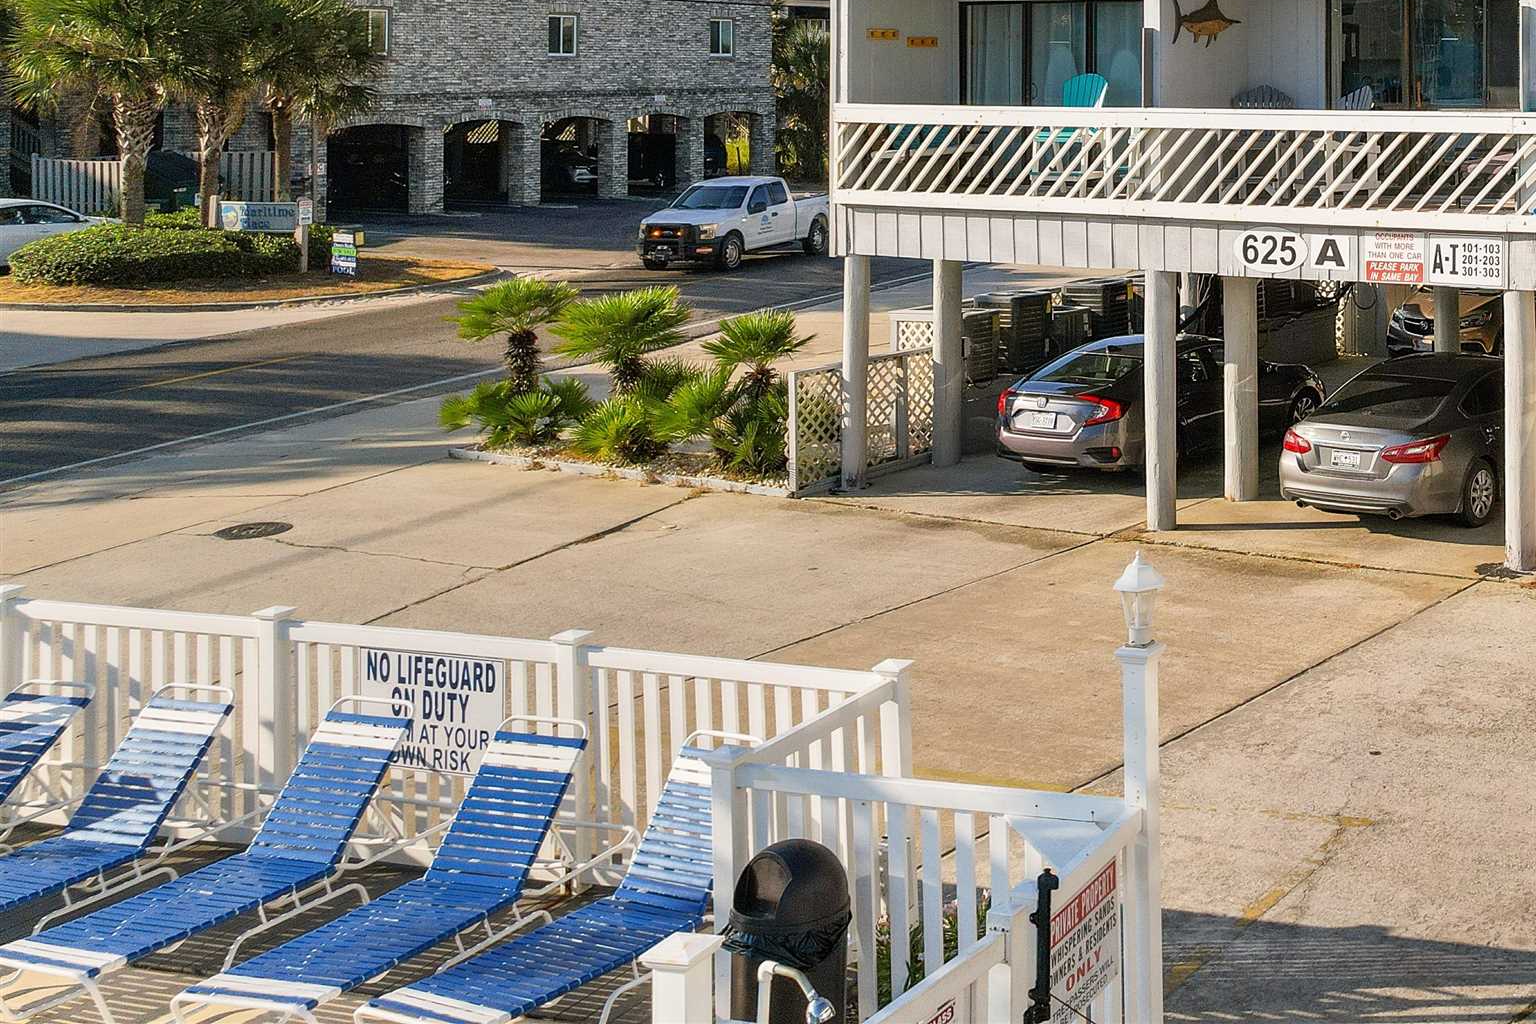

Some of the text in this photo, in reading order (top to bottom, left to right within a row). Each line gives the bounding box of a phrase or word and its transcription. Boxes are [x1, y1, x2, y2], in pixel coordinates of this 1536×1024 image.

[1242, 234, 1297, 266] 625
[1375, 232, 1414, 241] OCCUPANTS
[1394, 243, 1415, 251] MORE
[1315, 239, 1345, 267] A
[1369, 262, 1418, 272] PLEASE PARK
[1407, 252, 1422, 260] CAR
[1370, 271, 1418, 282] IN SAME BAY
[367, 651, 496, 693] NO LIFEGUARD
[391, 687, 470, 723] ON DUTY
[419, 724, 438, 744] AT
[444, 726, 490, 750] YOUR
[433, 749, 471, 772] RISK
[1050, 862, 1115, 946] PRIVATE PROPERTY
[1051, 896, 1115, 968] WHISPERING SANDS
[1086, 912, 1117, 955] RESIDENTS
[1066, 946, 1103, 991] ONLY
